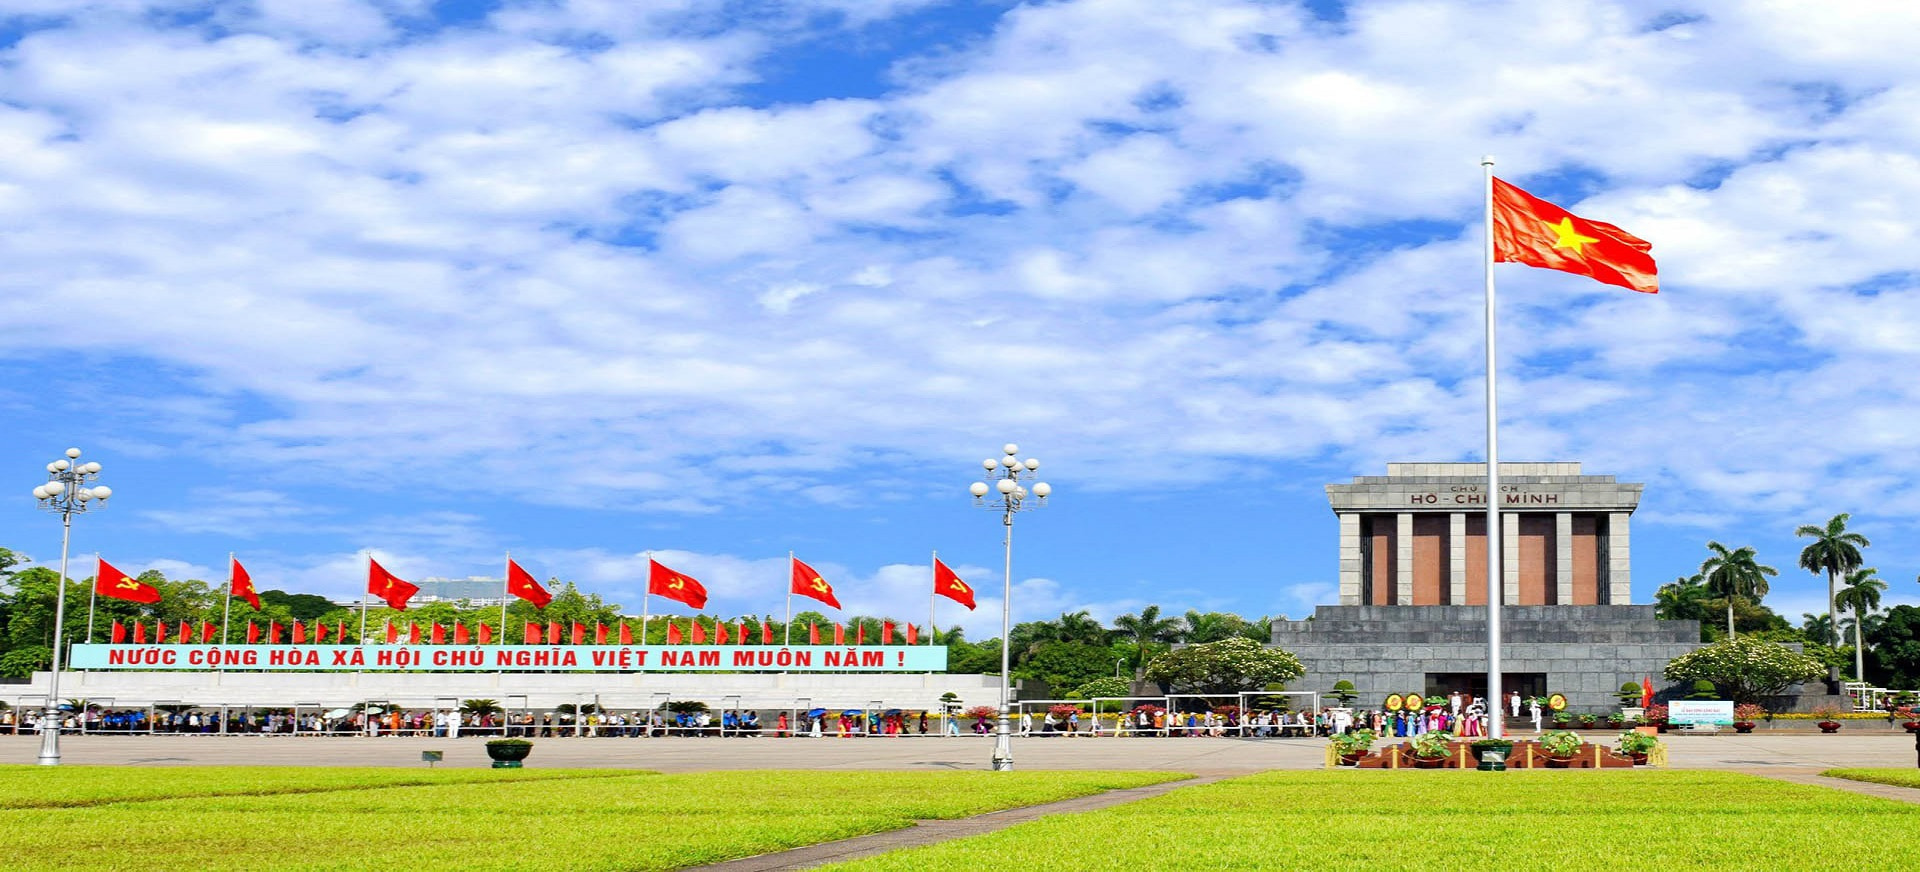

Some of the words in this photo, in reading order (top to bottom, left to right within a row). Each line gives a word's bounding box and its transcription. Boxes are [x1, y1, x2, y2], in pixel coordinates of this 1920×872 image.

[108, 646, 177, 665] NƯỚC
[188, 646, 258, 668] CỘNG
[269, 646, 320, 666] HÒA
[332, 647, 365, 666] XÃ
[377, 647, 421, 669] HỘI
[432, 646, 484, 666] CHỦ
[496, 647, 577, 667] NGHĨA
[591, 647, 649, 669] VIỆT
[661, 650, 721, 667] NAM
[733, 647, 812, 667] MUÔN
[824, 647, 885, 667] NĂM
[897, 651, 905, 667] !
